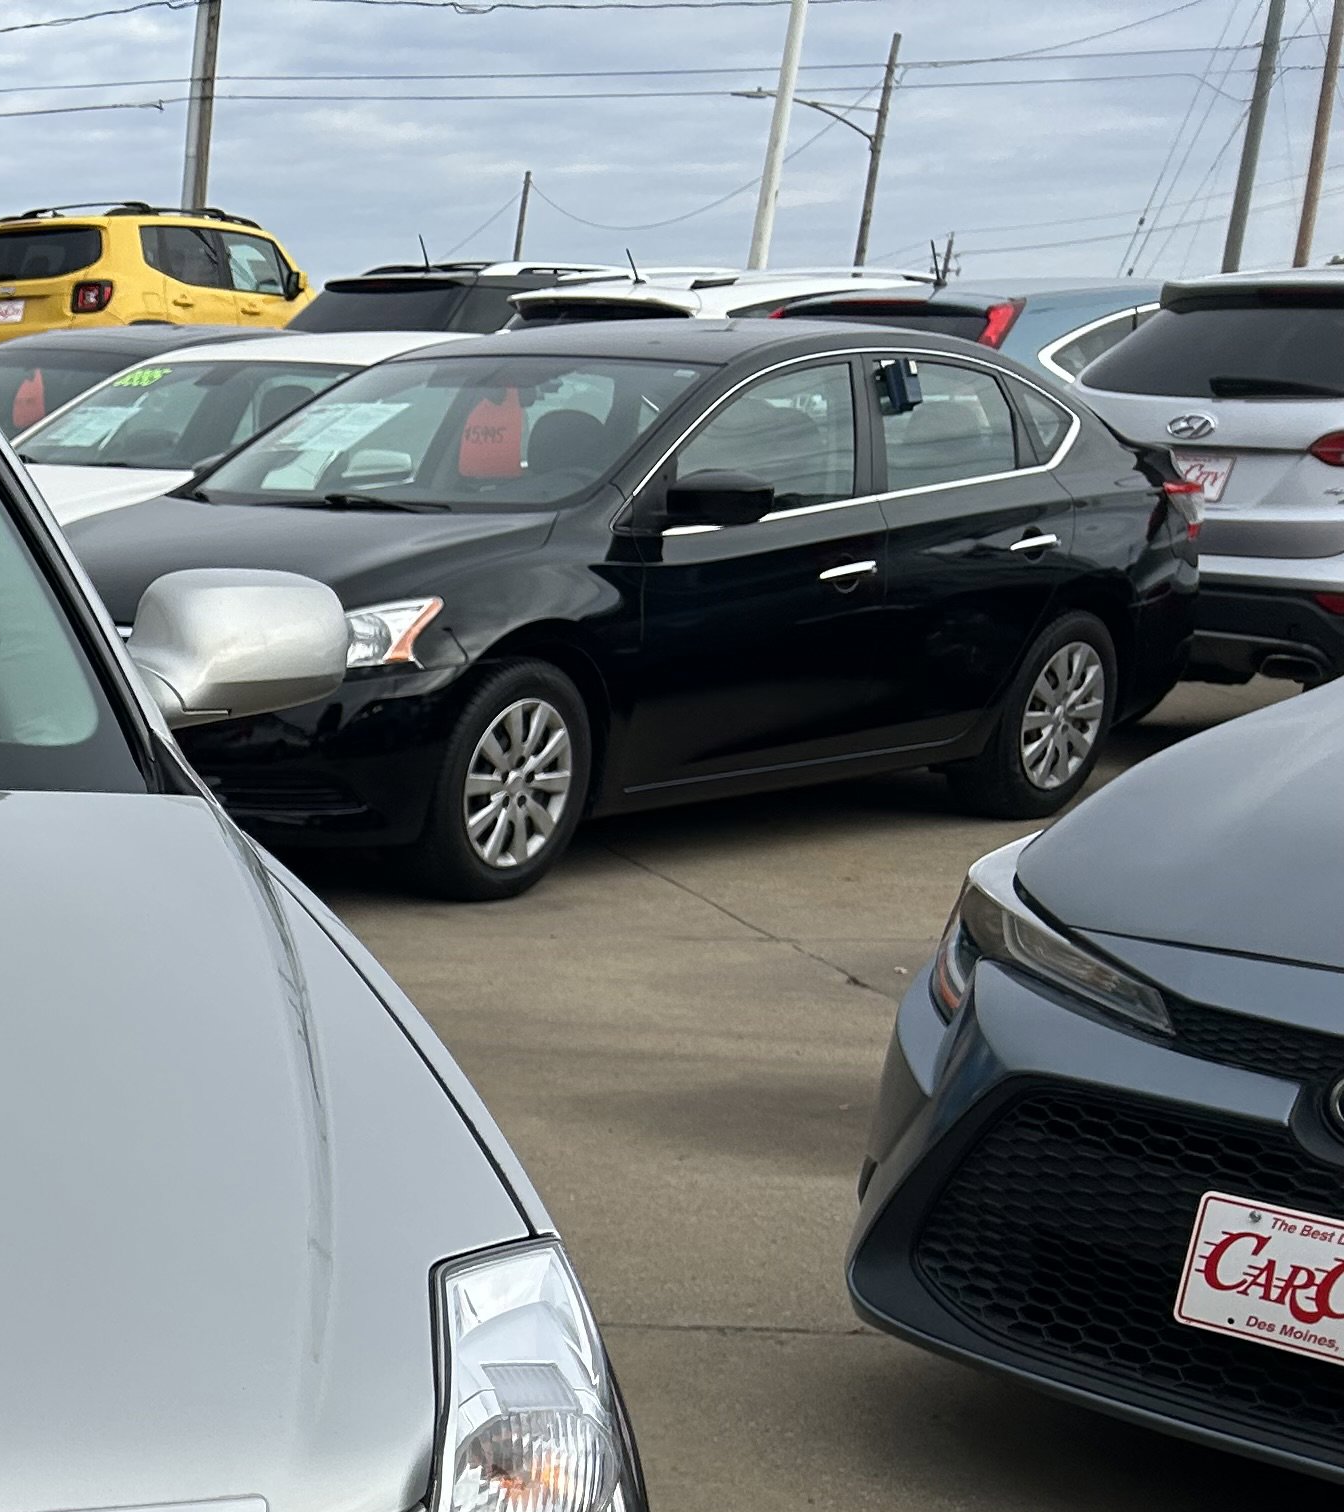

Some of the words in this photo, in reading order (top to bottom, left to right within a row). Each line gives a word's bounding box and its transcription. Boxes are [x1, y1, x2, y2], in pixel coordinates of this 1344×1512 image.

[1271, 1217, 1297, 1234] The
[1299, 1225, 1336, 1244] Best
[1245, 1315, 1275, 1333] Des
[1279, 1324, 1340, 1352] Moines,
